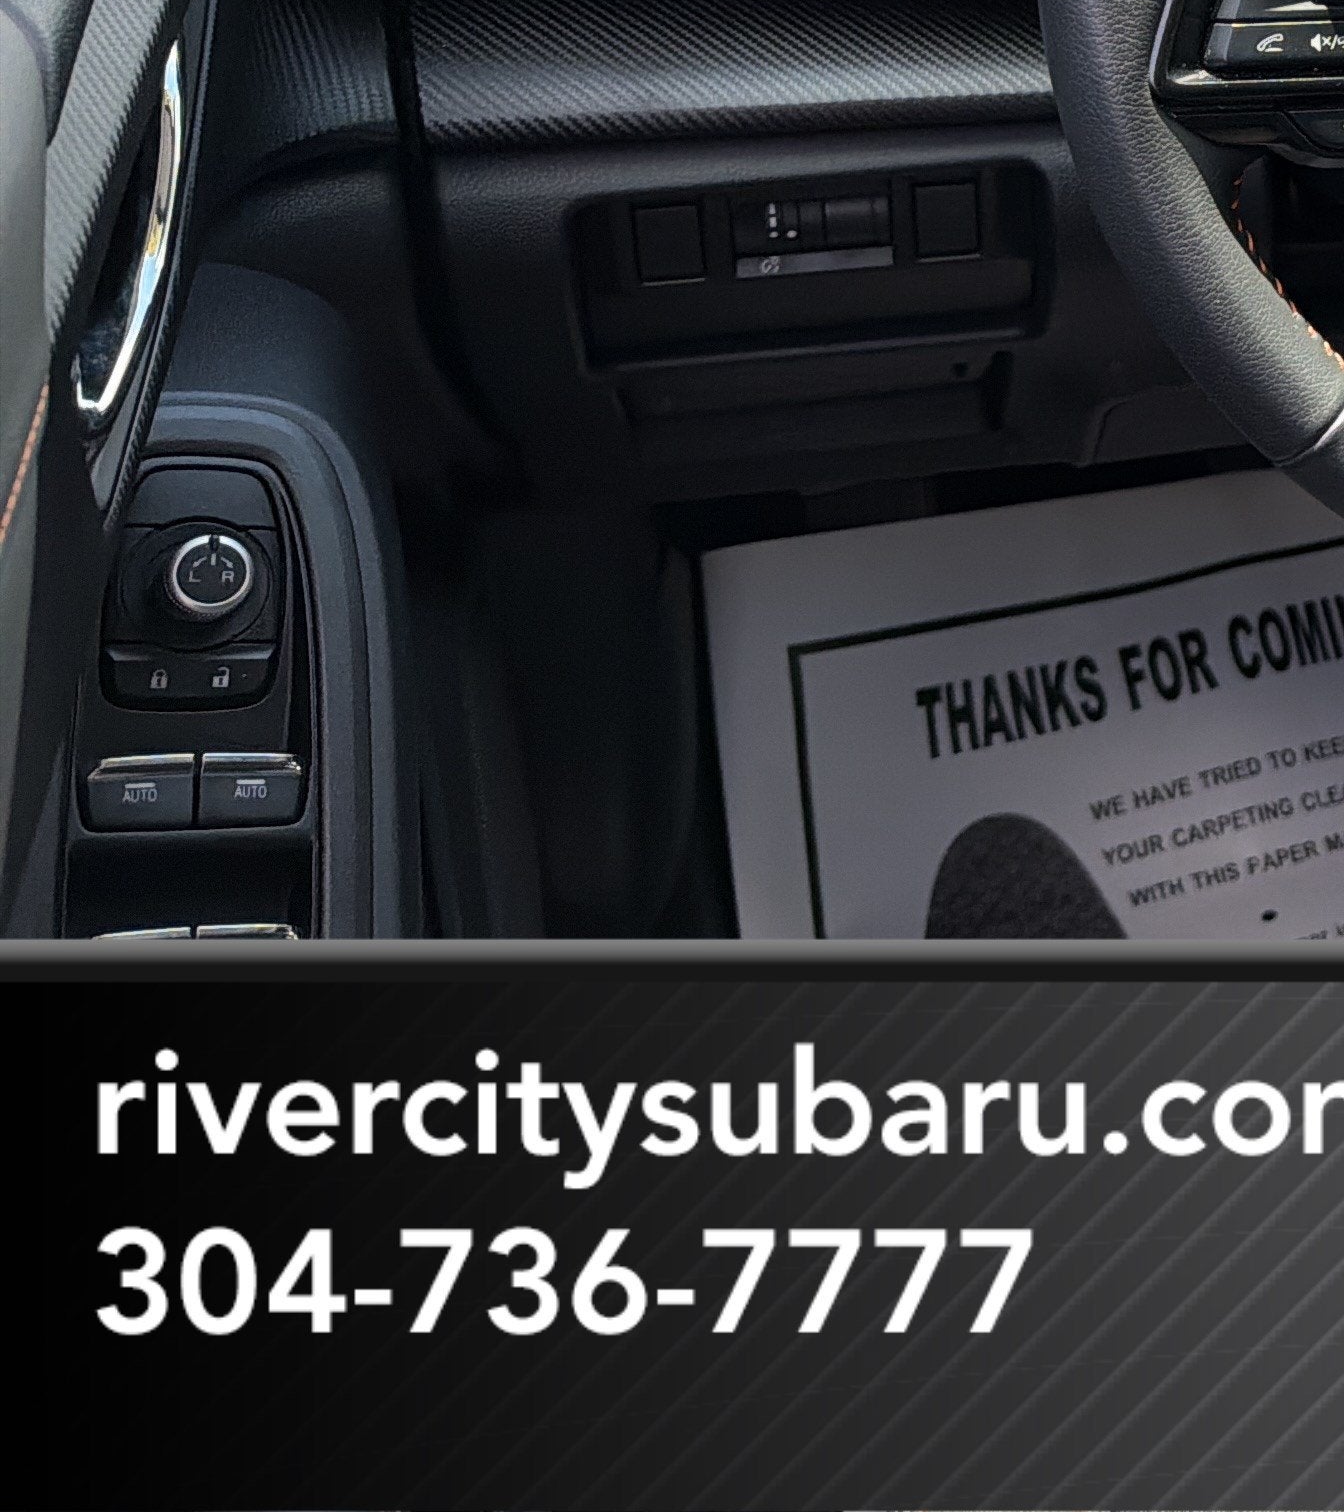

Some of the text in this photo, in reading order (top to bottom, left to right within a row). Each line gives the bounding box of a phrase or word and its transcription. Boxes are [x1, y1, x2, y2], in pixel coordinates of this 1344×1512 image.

[189, 570, 235, 583] L R
[916, 655, 1108, 759] THANKS
[1119, 627, 1220, 712] FOR
[122, 784, 268, 803] AUTO AUTO
[1089, 794, 1128, 821] WE
[1132, 775, 1193, 810] HAVE
[1198, 756, 1262, 789] TRIED
[1266, 746, 1298, 771] TO
[1102, 833, 1165, 867] YOUR
[1171, 796, 1295, 848] CARPETING
[1128, 876, 1186, 908] WITH
[1192, 861, 1241, 890] THIS
[1246, 839, 1320, 876] PAPER
